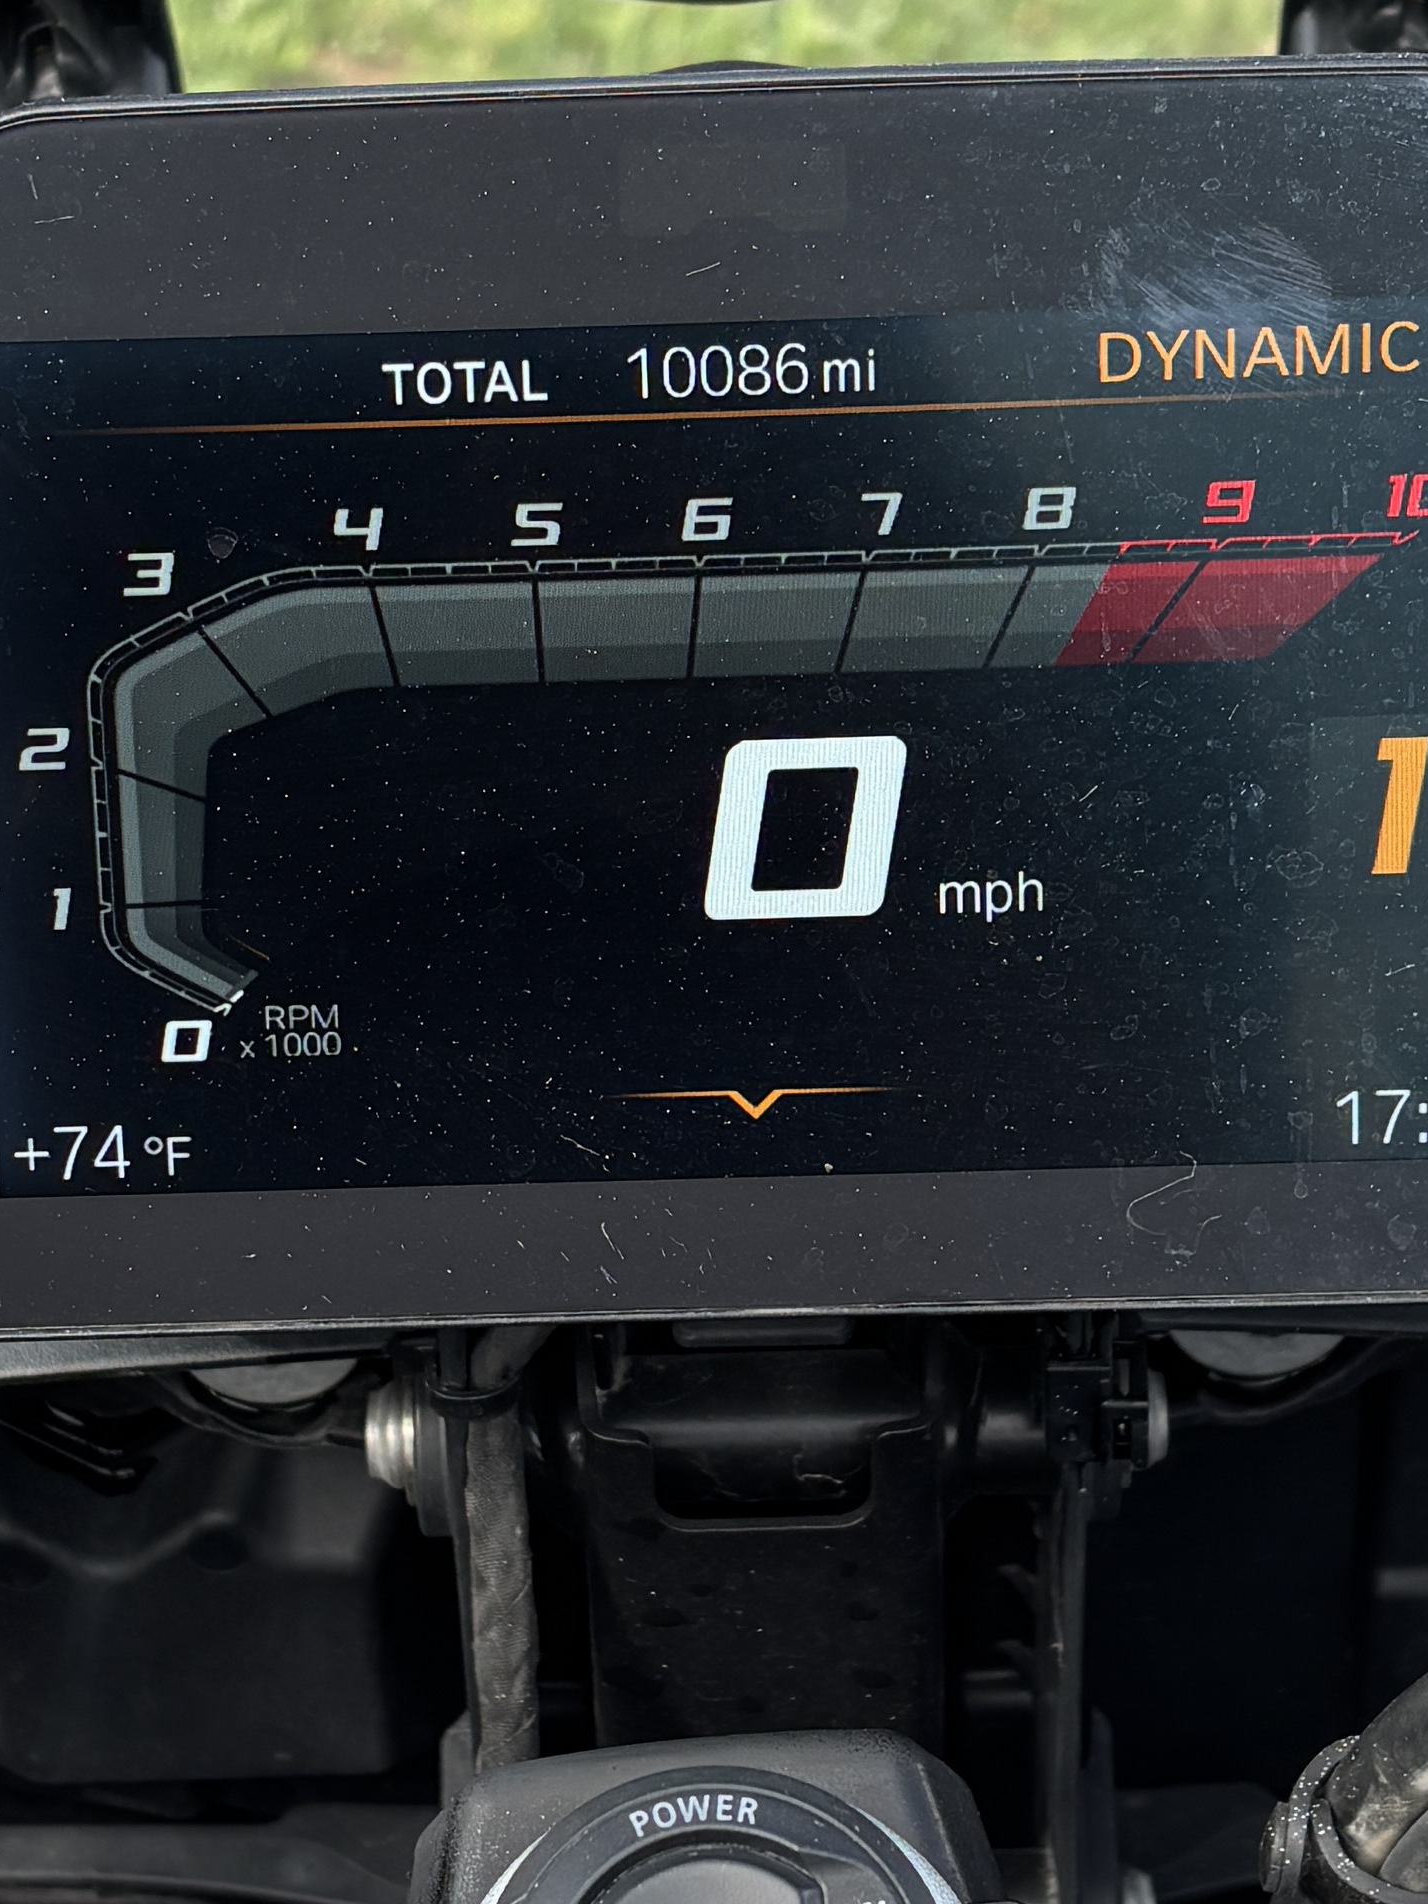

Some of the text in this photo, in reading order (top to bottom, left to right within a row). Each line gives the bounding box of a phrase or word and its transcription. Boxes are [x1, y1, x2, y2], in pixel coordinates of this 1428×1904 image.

[382, 342, 876, 406] TOTAL 10086 mi
[1098, 320, 1421, 384] DYNAMIC
[681, 498, 733, 542] 6
[861, 492, 903, 536] 7
[1023, 487, 1077, 531] 8
[1203, 480, 1257, 524] 9
[333, 507, 384, 552] 4
[511, 503, 564, 547] 5
[123, 553, 175, 597] 3
[18, 727, 70, 771] 2
[704, 736, 908, 920] 0
[53, 887, 72, 931] 1
[939, 870, 1044, 923] mph
[264, 1004, 339, 1030] RPM
[160, 1020, 213, 1063] 0
[264, 1032, 342, 1057] 1000
[14, 1125, 131, 1181] +74
[628, 1794, 759, 1838] POWER
